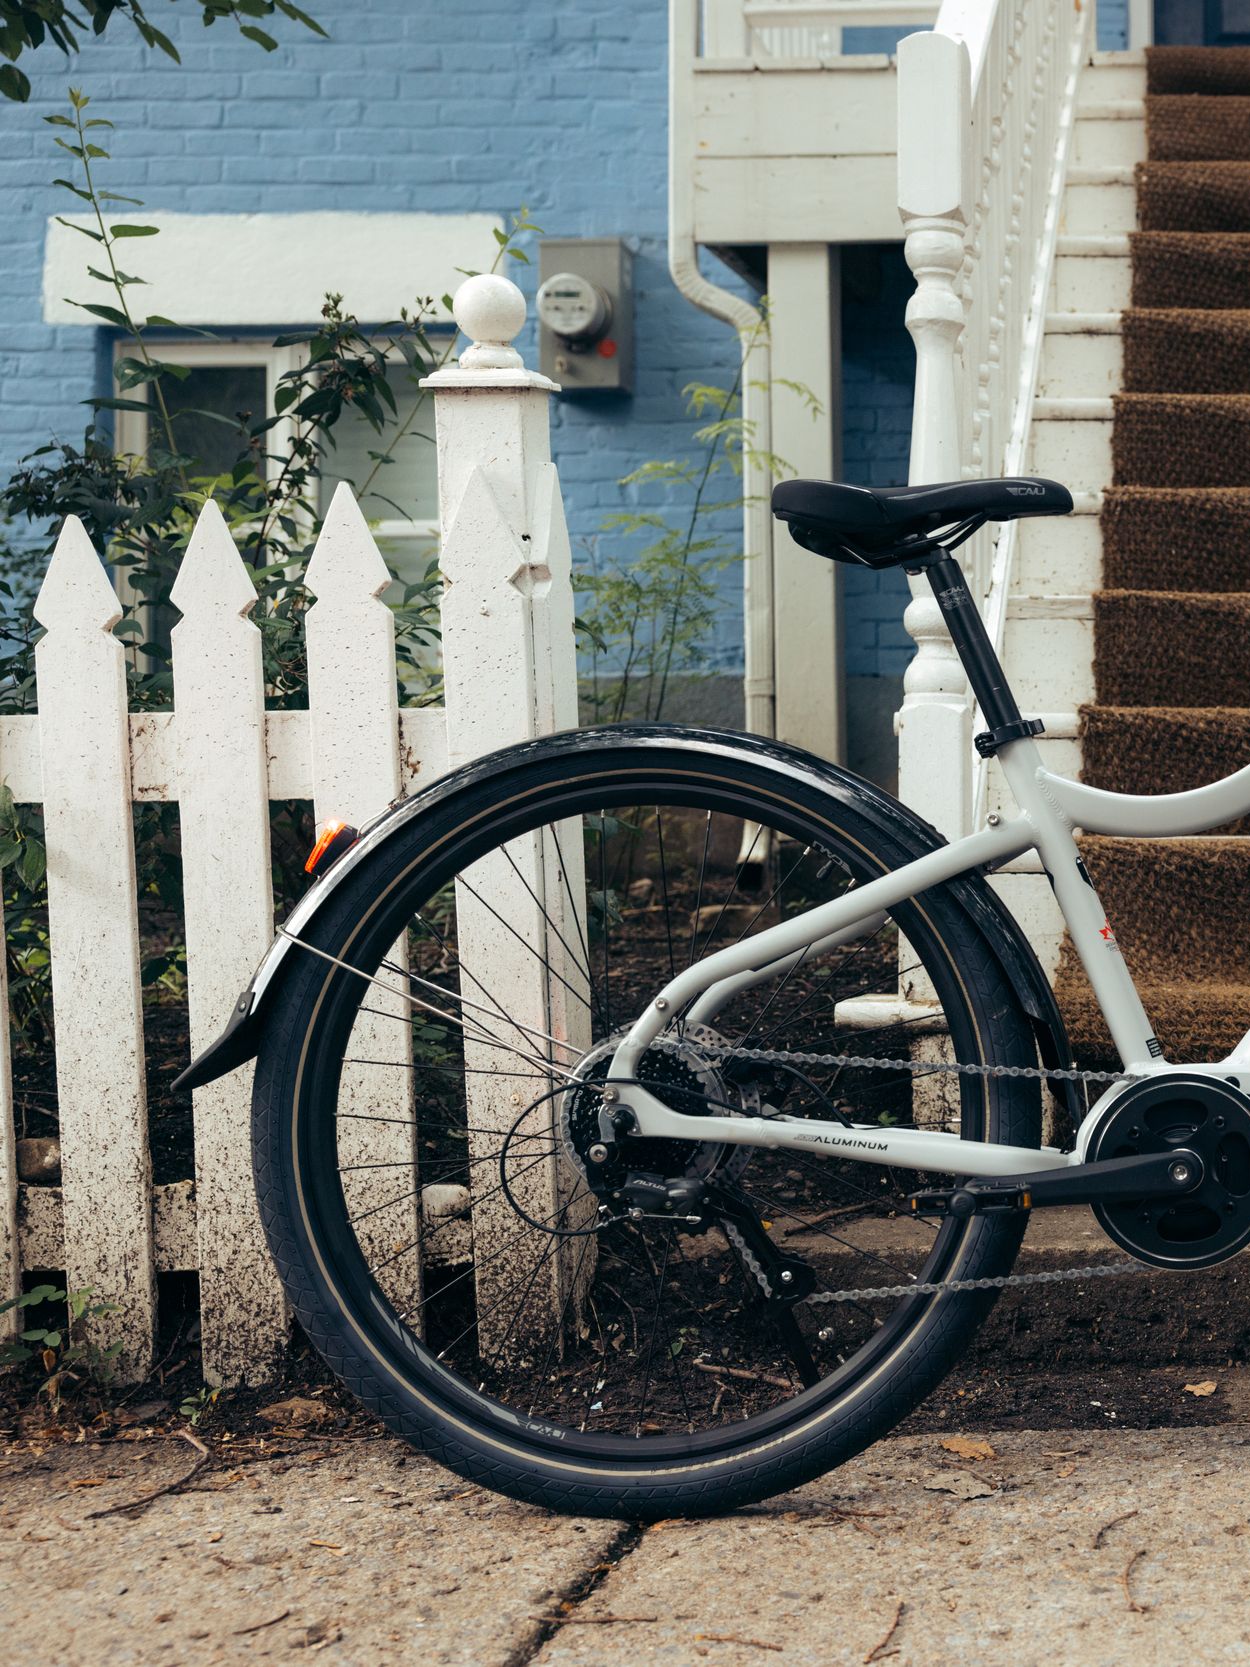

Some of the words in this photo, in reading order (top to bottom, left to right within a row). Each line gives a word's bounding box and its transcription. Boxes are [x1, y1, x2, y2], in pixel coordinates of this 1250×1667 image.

[1018, 487, 1046, 496] CAVU
[814, 1136, 889, 1151] ALUMINUM
[632, 1179, 668, 1191] ALTUS
